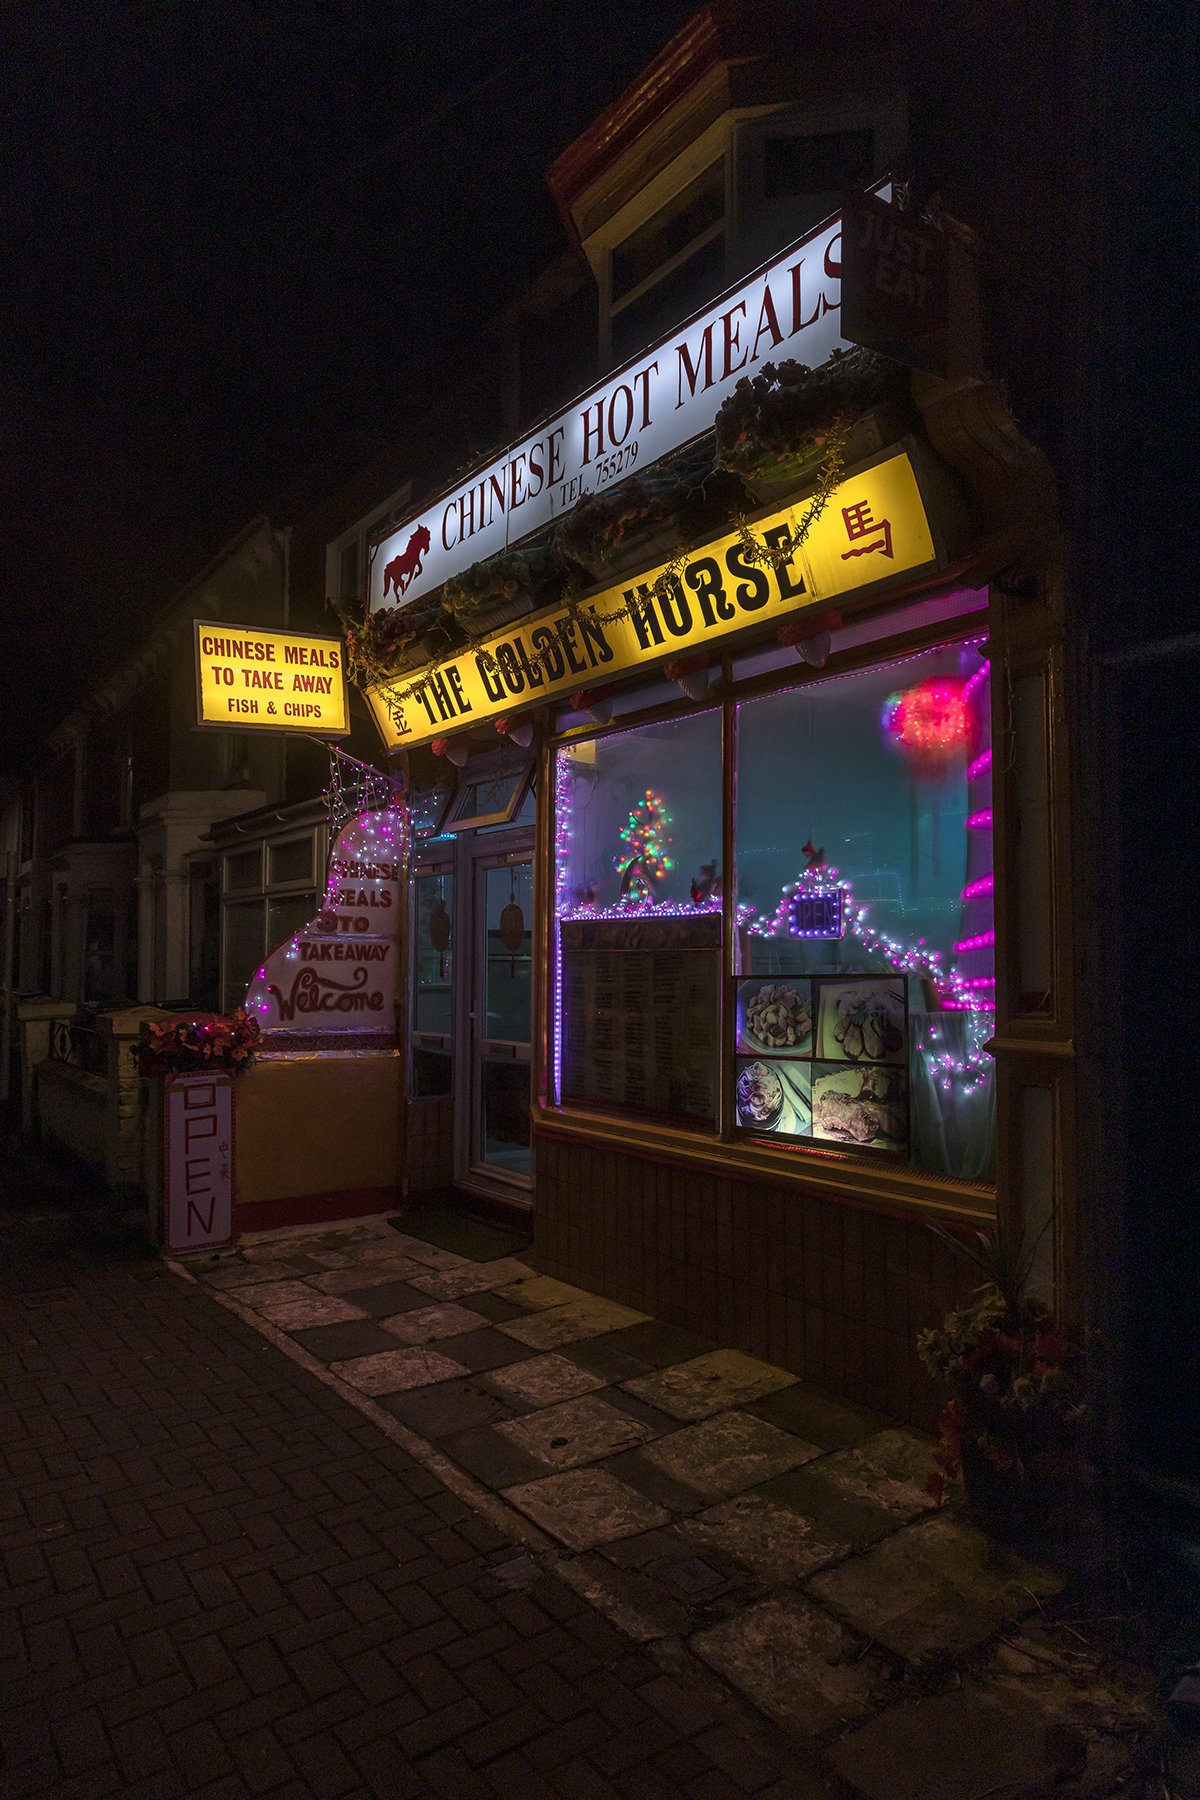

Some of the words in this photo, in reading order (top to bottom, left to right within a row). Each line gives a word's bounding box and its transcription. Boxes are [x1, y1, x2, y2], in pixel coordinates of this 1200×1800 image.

[858, 210, 932, 270] JUST
[876, 255, 932, 307] EAT
[442, 426, 566, 551] CHINESE
[580, 361, 659, 468] HOT
[560, 475, 589, 507] TEL.
[595, 441, 639, 486] 755279
[841, 500, 894, 559] 馬
[414, 665, 473, 725] THE
[475, 606, 614, 703] GOLDEN
[622, 523, 807, 650] HORSE
[202, 637, 275, 661] CHINESE
[284, 646, 340, 669] MEALS
[212, 666, 234, 686] TO
[242, 669, 284, 690] TAKE
[292, 674, 333, 694] AWAY
[228, 698, 259, 714] FISH
[266, 701, 277, 715] &
[284, 703, 322, 718] CHIPS
[299, 943, 390, 961] TAKEAWAY
[268, 967, 384, 1021] Welcome
[184, 1083, 217, 1236] OPEN
